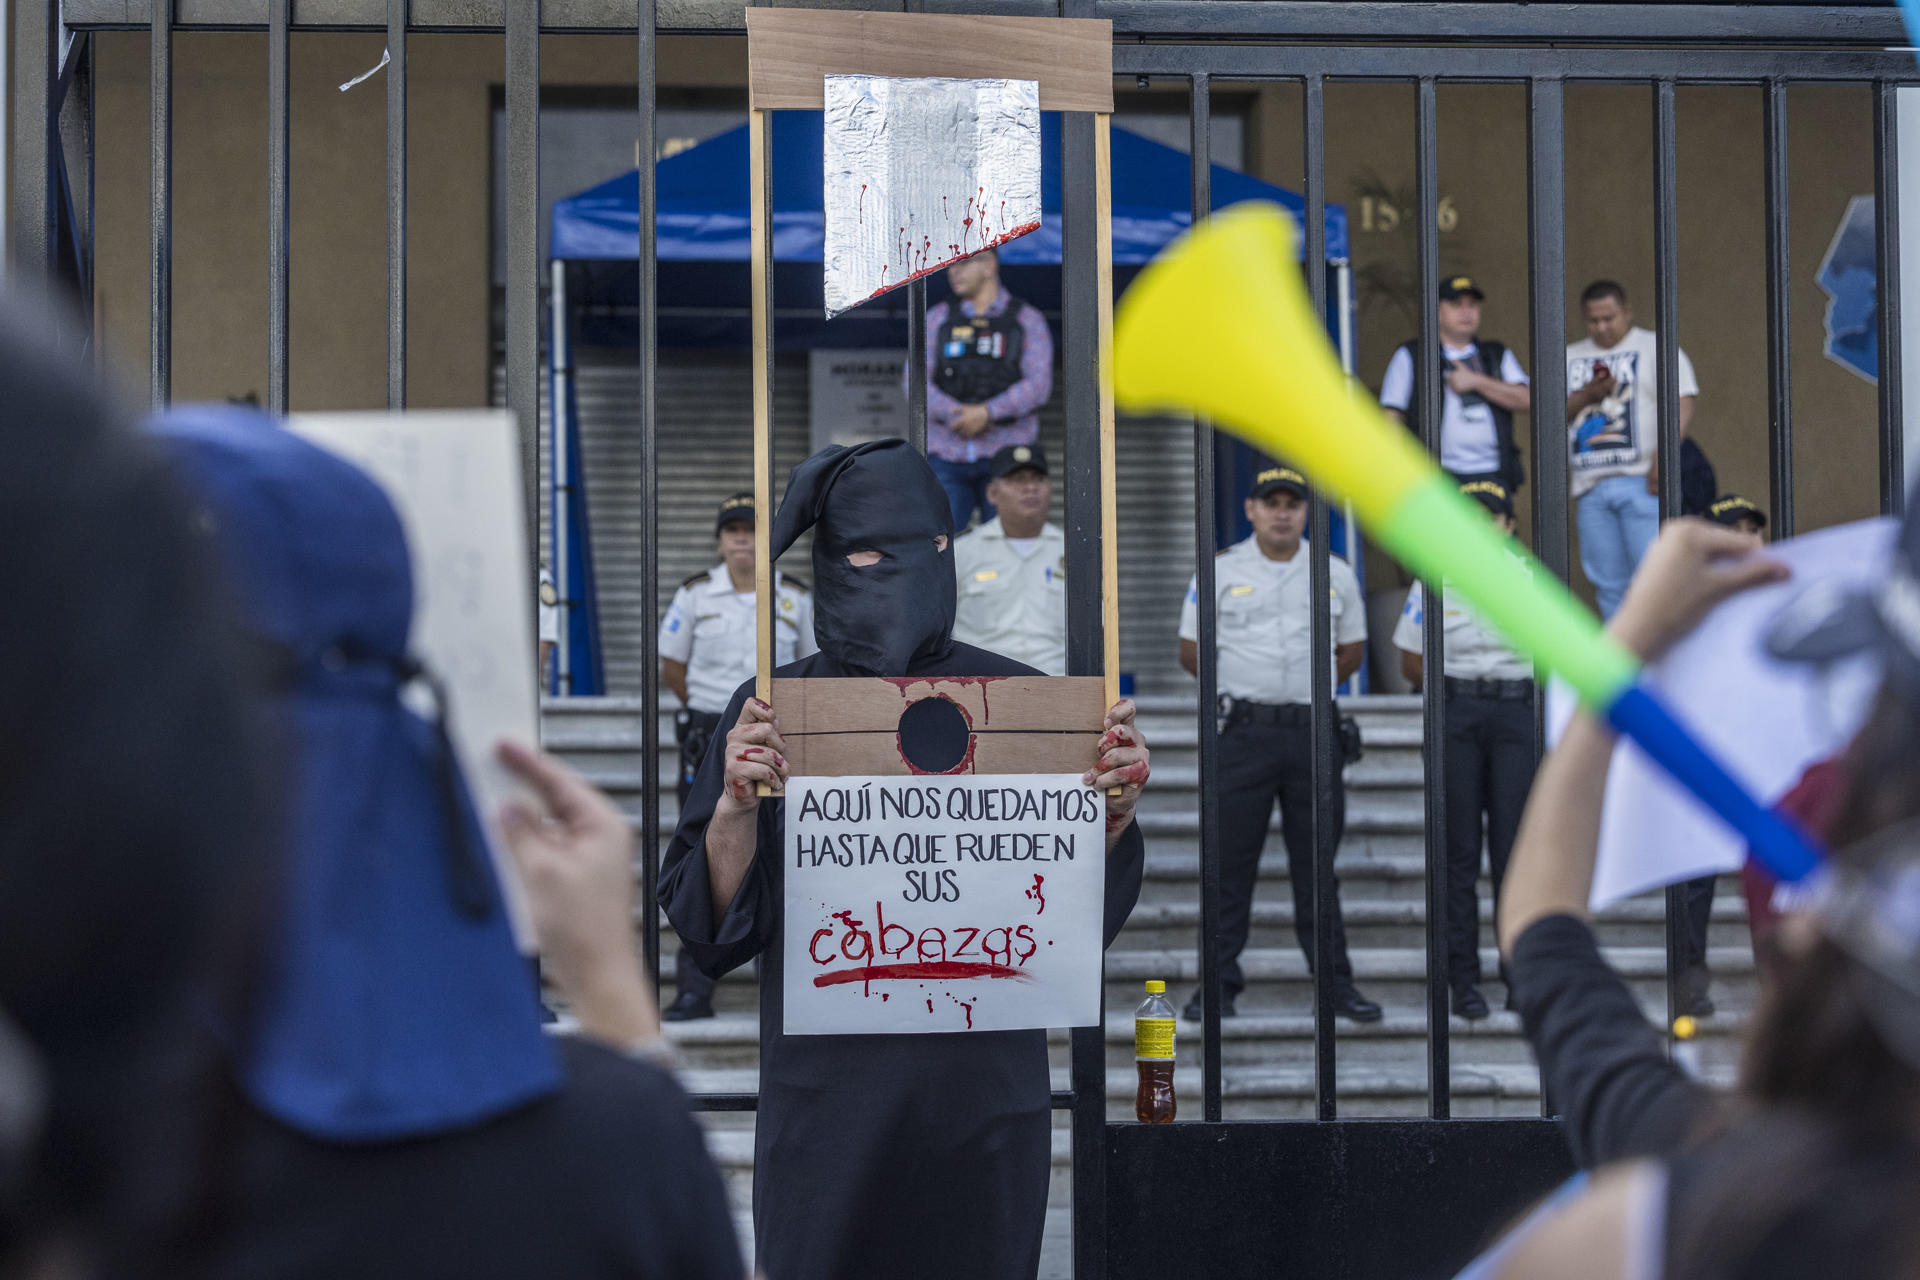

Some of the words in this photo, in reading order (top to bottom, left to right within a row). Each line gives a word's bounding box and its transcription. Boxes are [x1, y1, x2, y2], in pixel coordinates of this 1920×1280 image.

[799, 782, 872, 822] AQUÍ
[880, 787, 941, 820] NOS
[946, 787, 1098, 823] QUEDAMOS
[797, 834, 889, 868] HASTA
[893, 832, 947, 864] QUE
[956, 833, 1075, 862] RUEDEN
[902, 869, 960, 902] SUS
